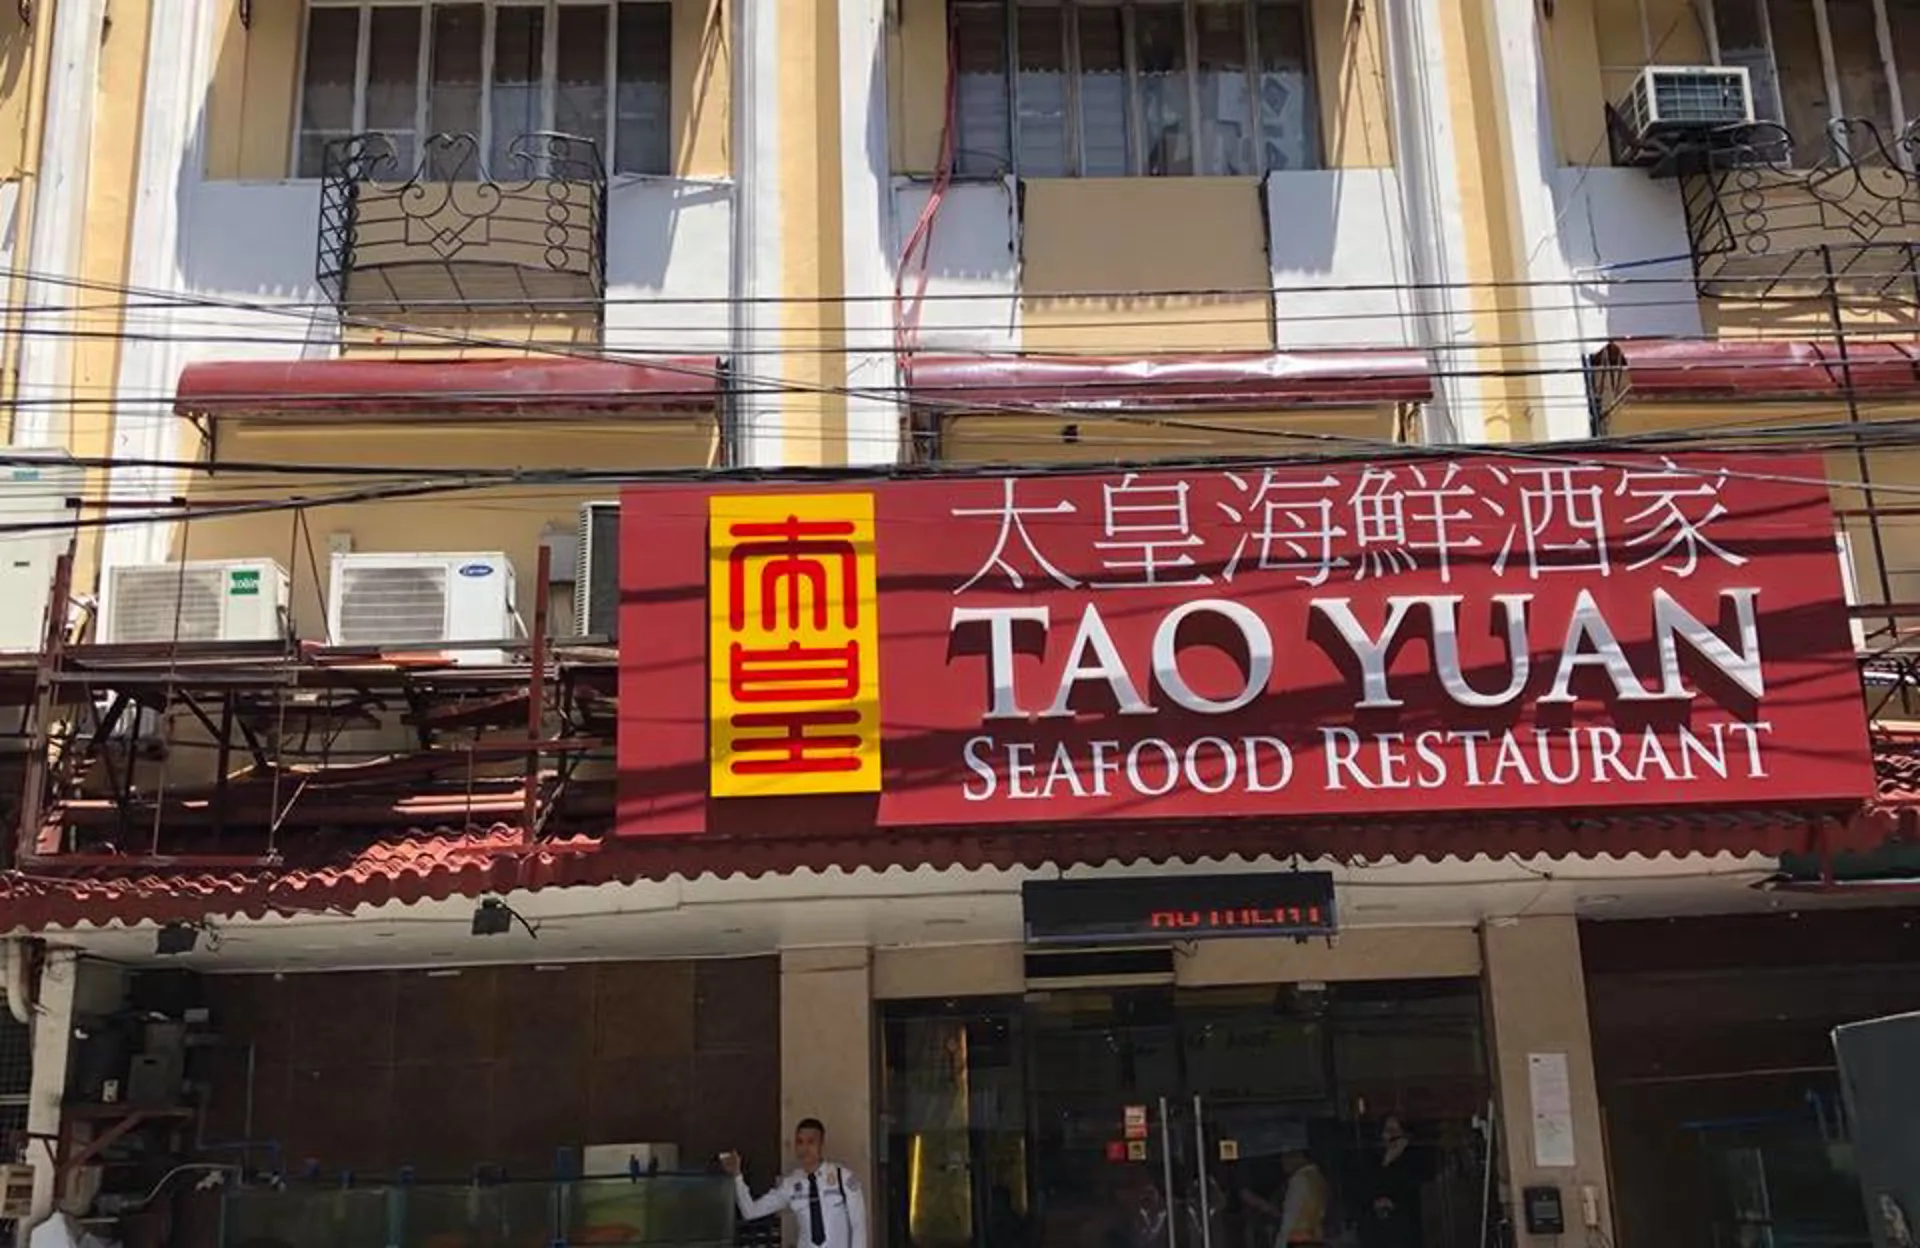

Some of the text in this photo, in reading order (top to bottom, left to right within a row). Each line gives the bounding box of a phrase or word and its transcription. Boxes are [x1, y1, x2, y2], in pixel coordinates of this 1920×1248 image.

[951, 456, 1749, 595] 太皇海鮮酒家
[951, 587, 1765, 719] TAO YUAN
[963, 721, 1773, 801] SEAFOOD RESTAURANT
